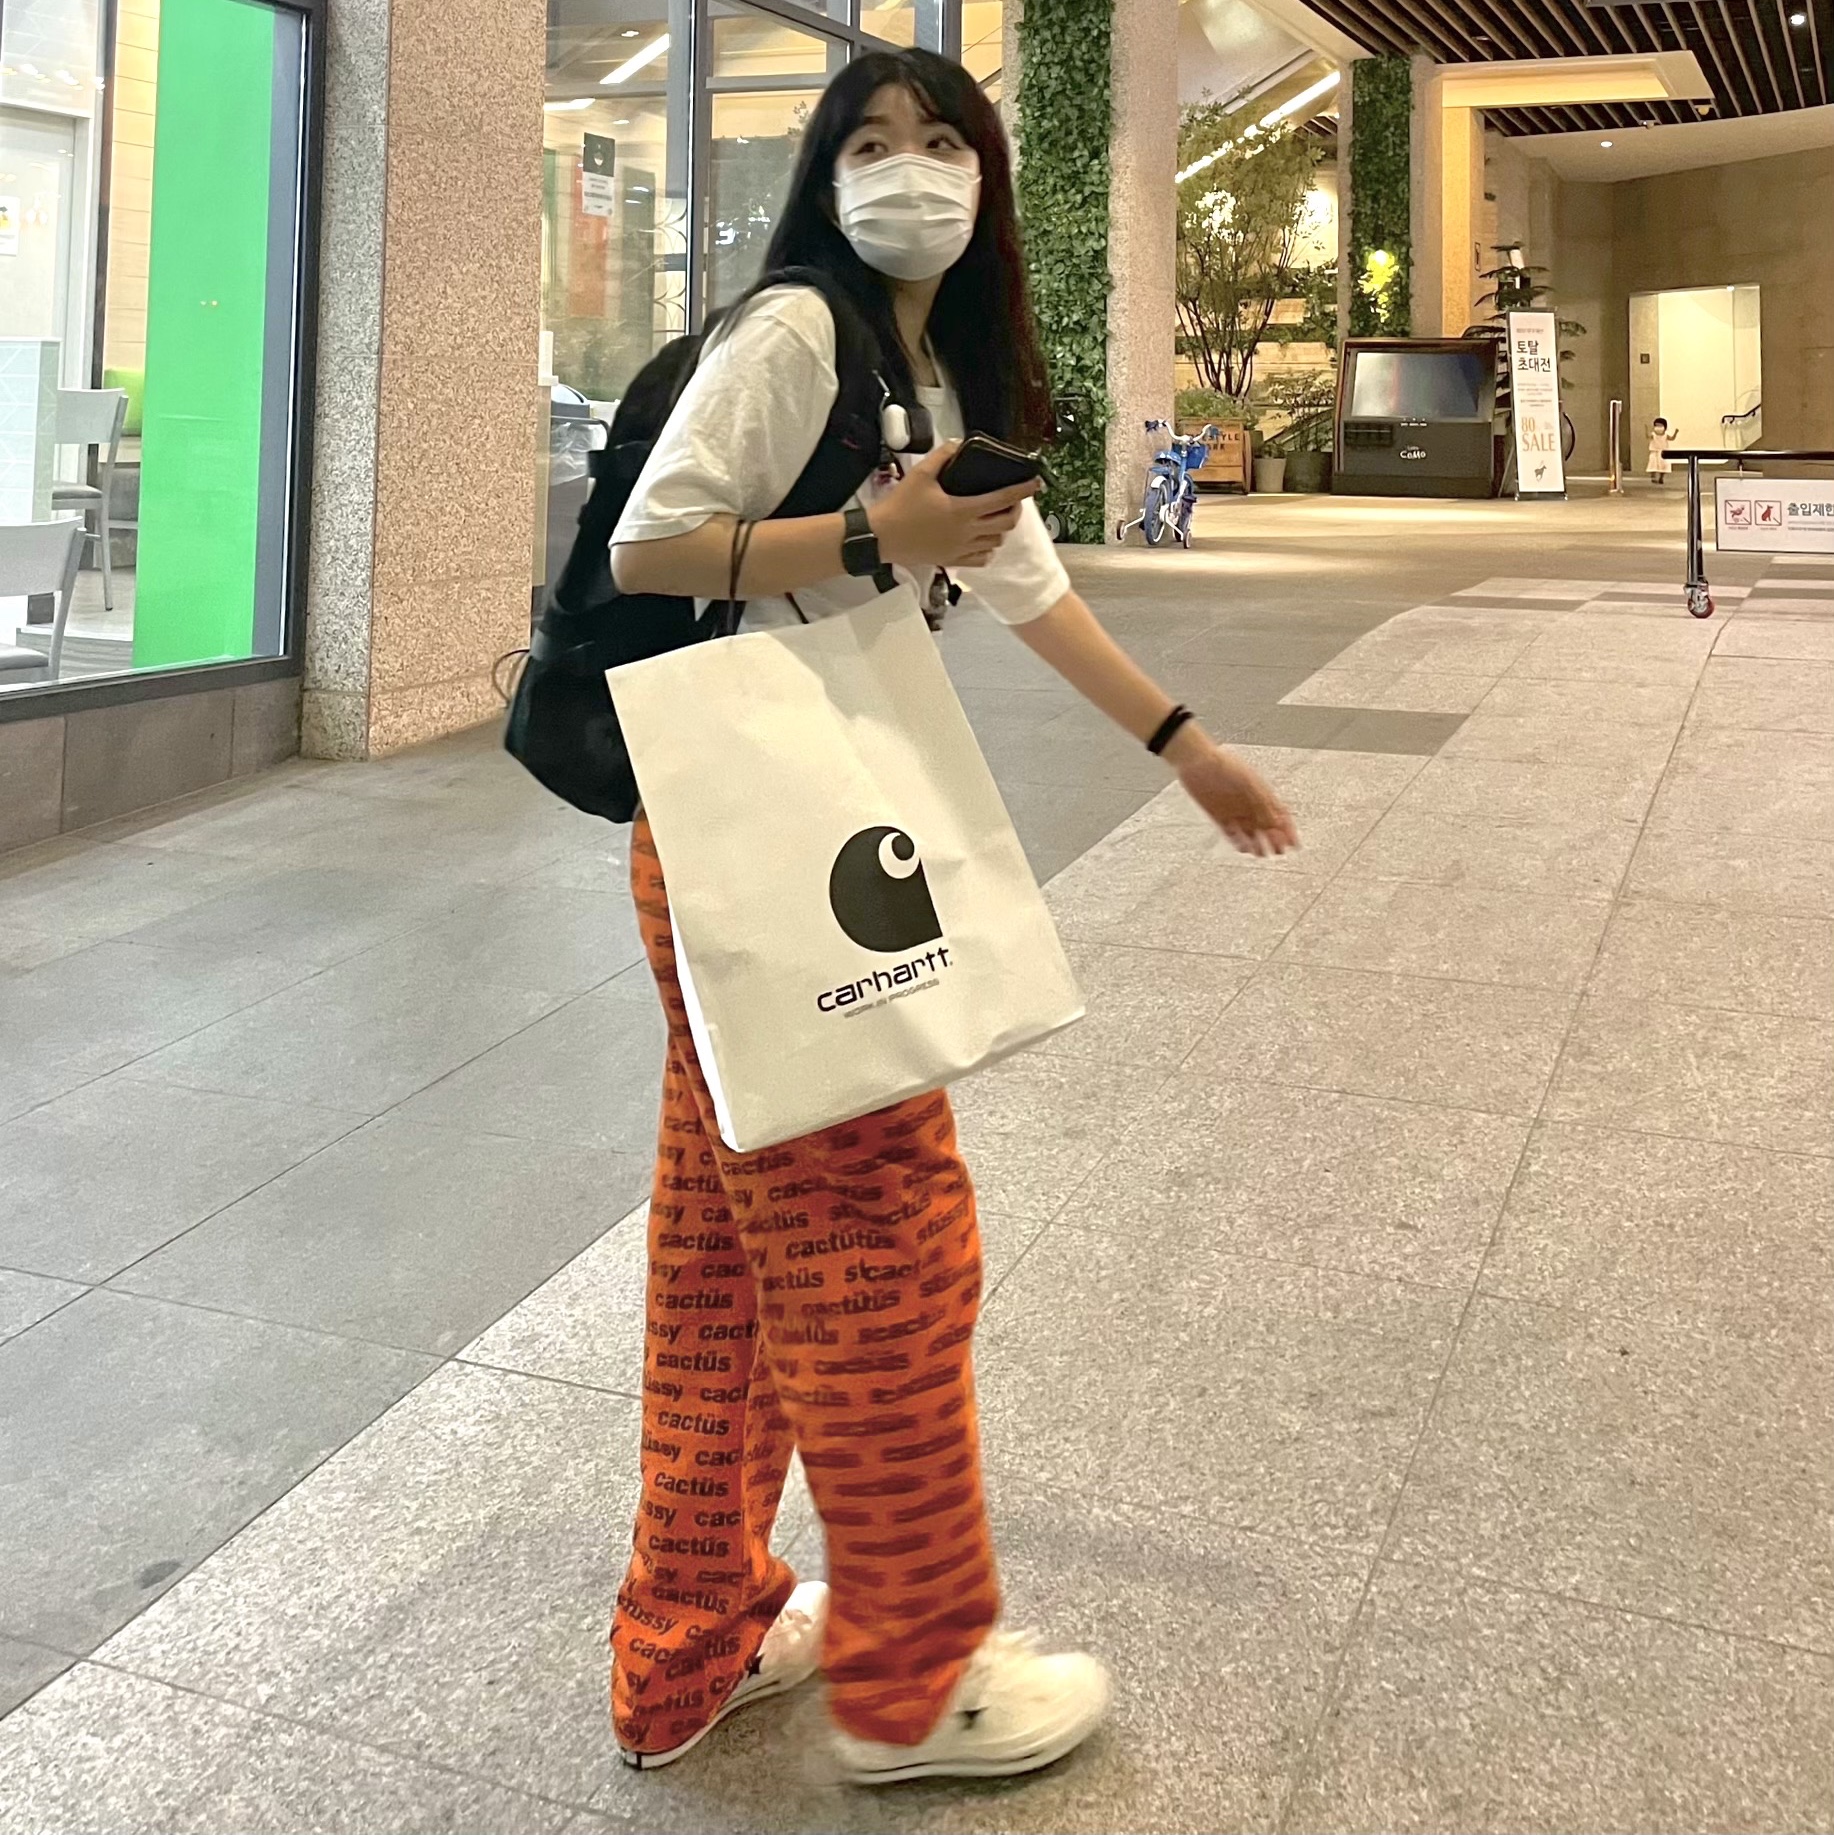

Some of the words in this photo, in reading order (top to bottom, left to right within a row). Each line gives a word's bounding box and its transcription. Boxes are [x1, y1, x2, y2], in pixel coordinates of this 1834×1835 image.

[1517, 357, 1551, 372] 초대전
[1522, 433, 1556, 451] SALE
[817, 947, 949, 1012] carhartt
[655, 1288, 734, 1309] cactüs
[656, 1351, 731, 1372] cactüs
[657, 1410, 730, 1436] cactüs
[654, 1472, 729, 1497] cactüs
